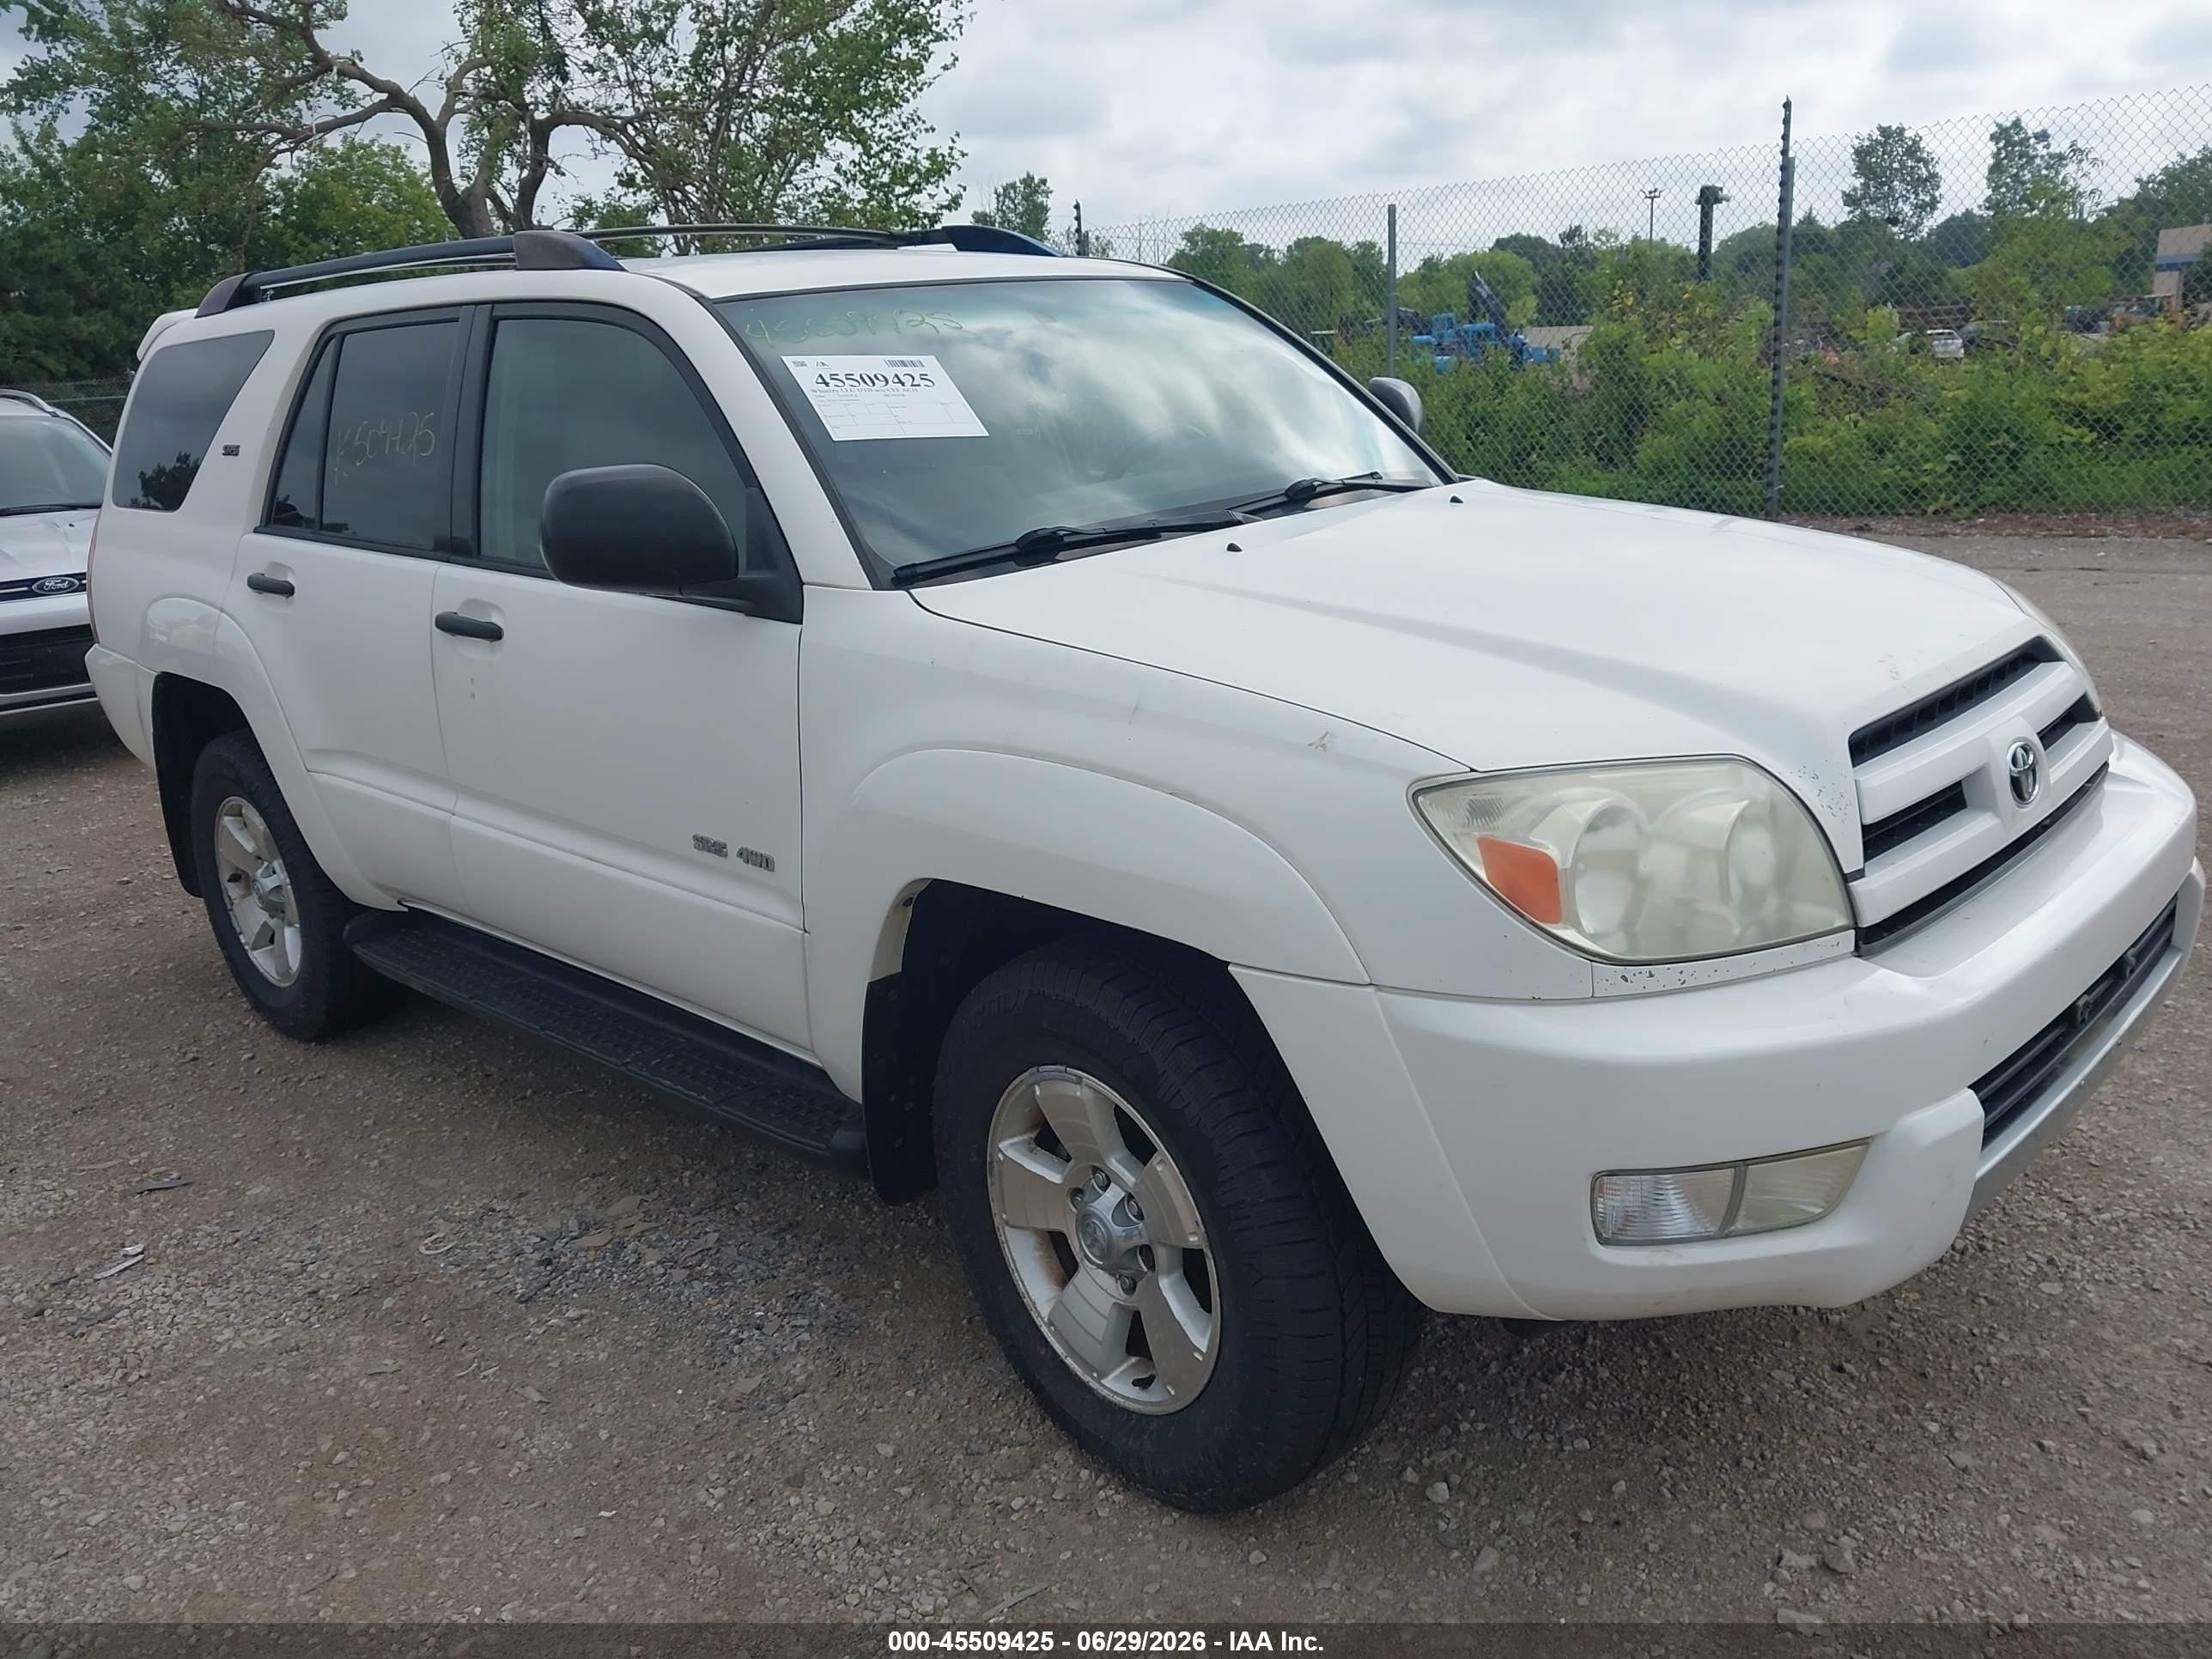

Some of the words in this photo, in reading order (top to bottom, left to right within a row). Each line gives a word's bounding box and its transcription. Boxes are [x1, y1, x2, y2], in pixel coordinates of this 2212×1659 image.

[815, 373, 935, 388] 45509425
[43, 579, 69, 591] Ford
[736, 846, 775, 872] 4WD
